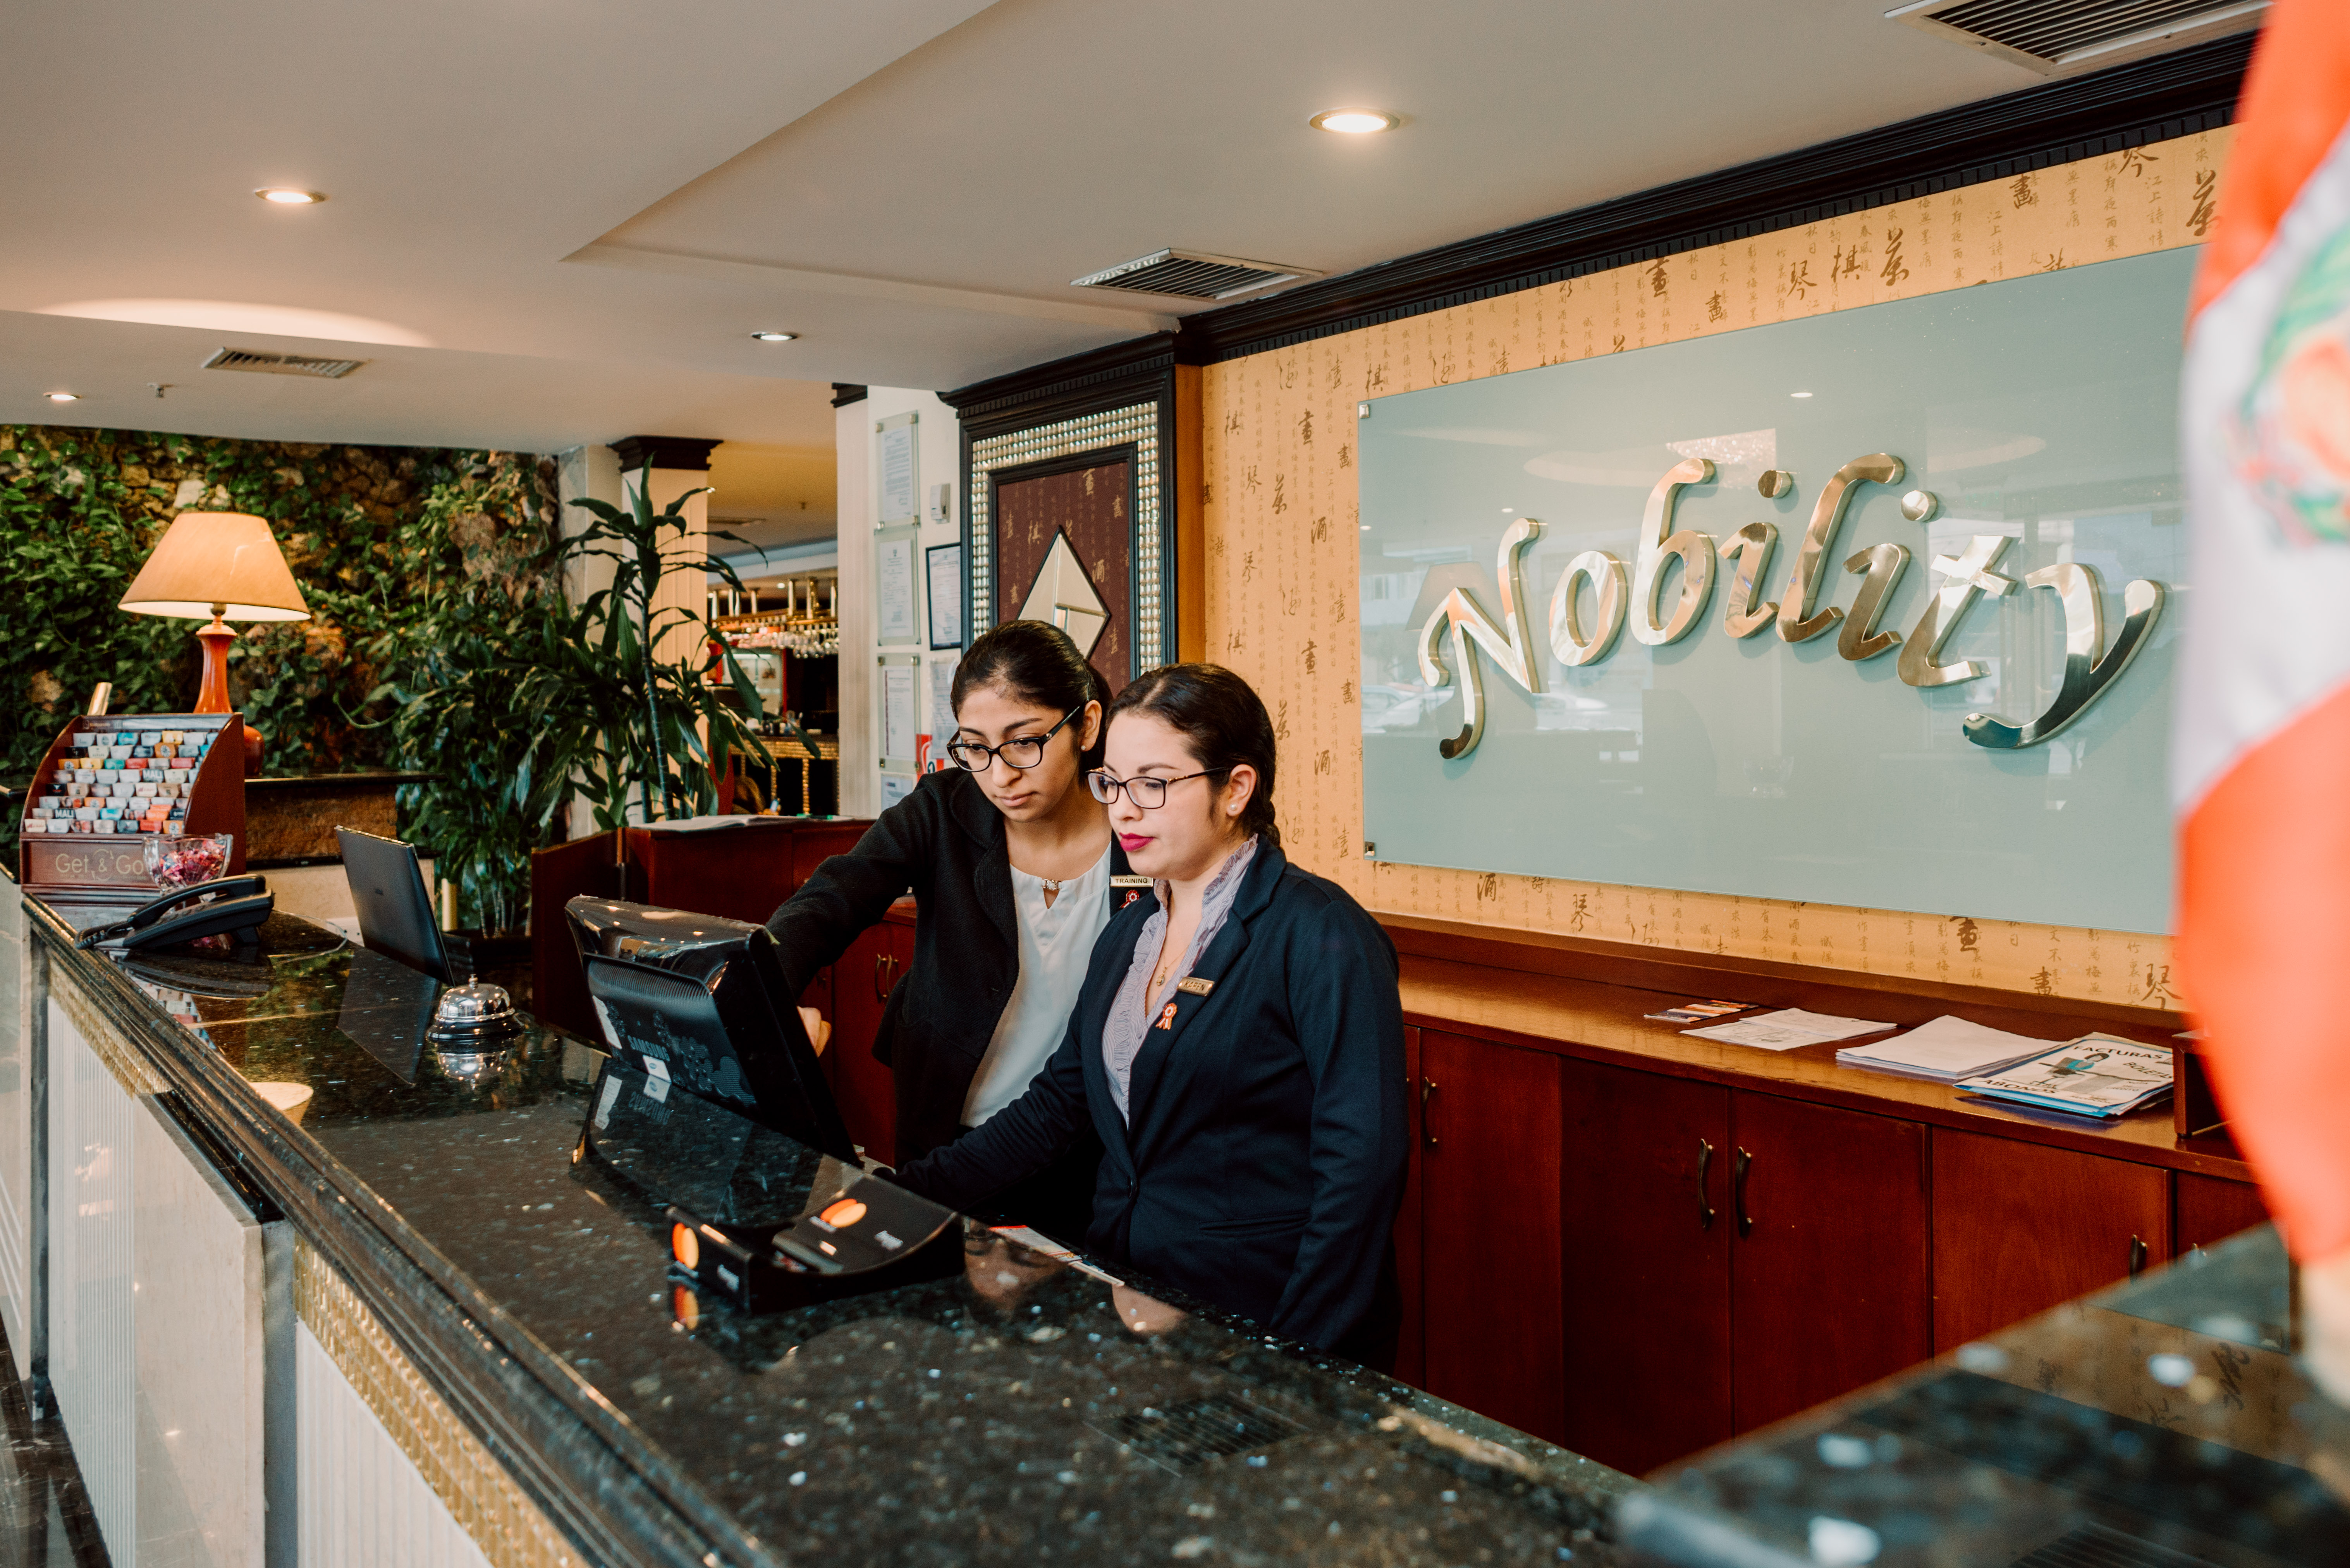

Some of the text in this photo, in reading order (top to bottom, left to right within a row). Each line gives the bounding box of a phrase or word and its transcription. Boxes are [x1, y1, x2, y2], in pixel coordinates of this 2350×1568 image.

[1831, 244, 1861, 283] 棋
[1418, 452, 2166, 759] Nobility
[55, 853, 144, 875] Get & Go
[627, 1035, 670, 1062] SAMSUNG
[2073, 1046, 2163, 1059] FACTURAS
[1980, 1079, 2058, 1094] ABONOS
